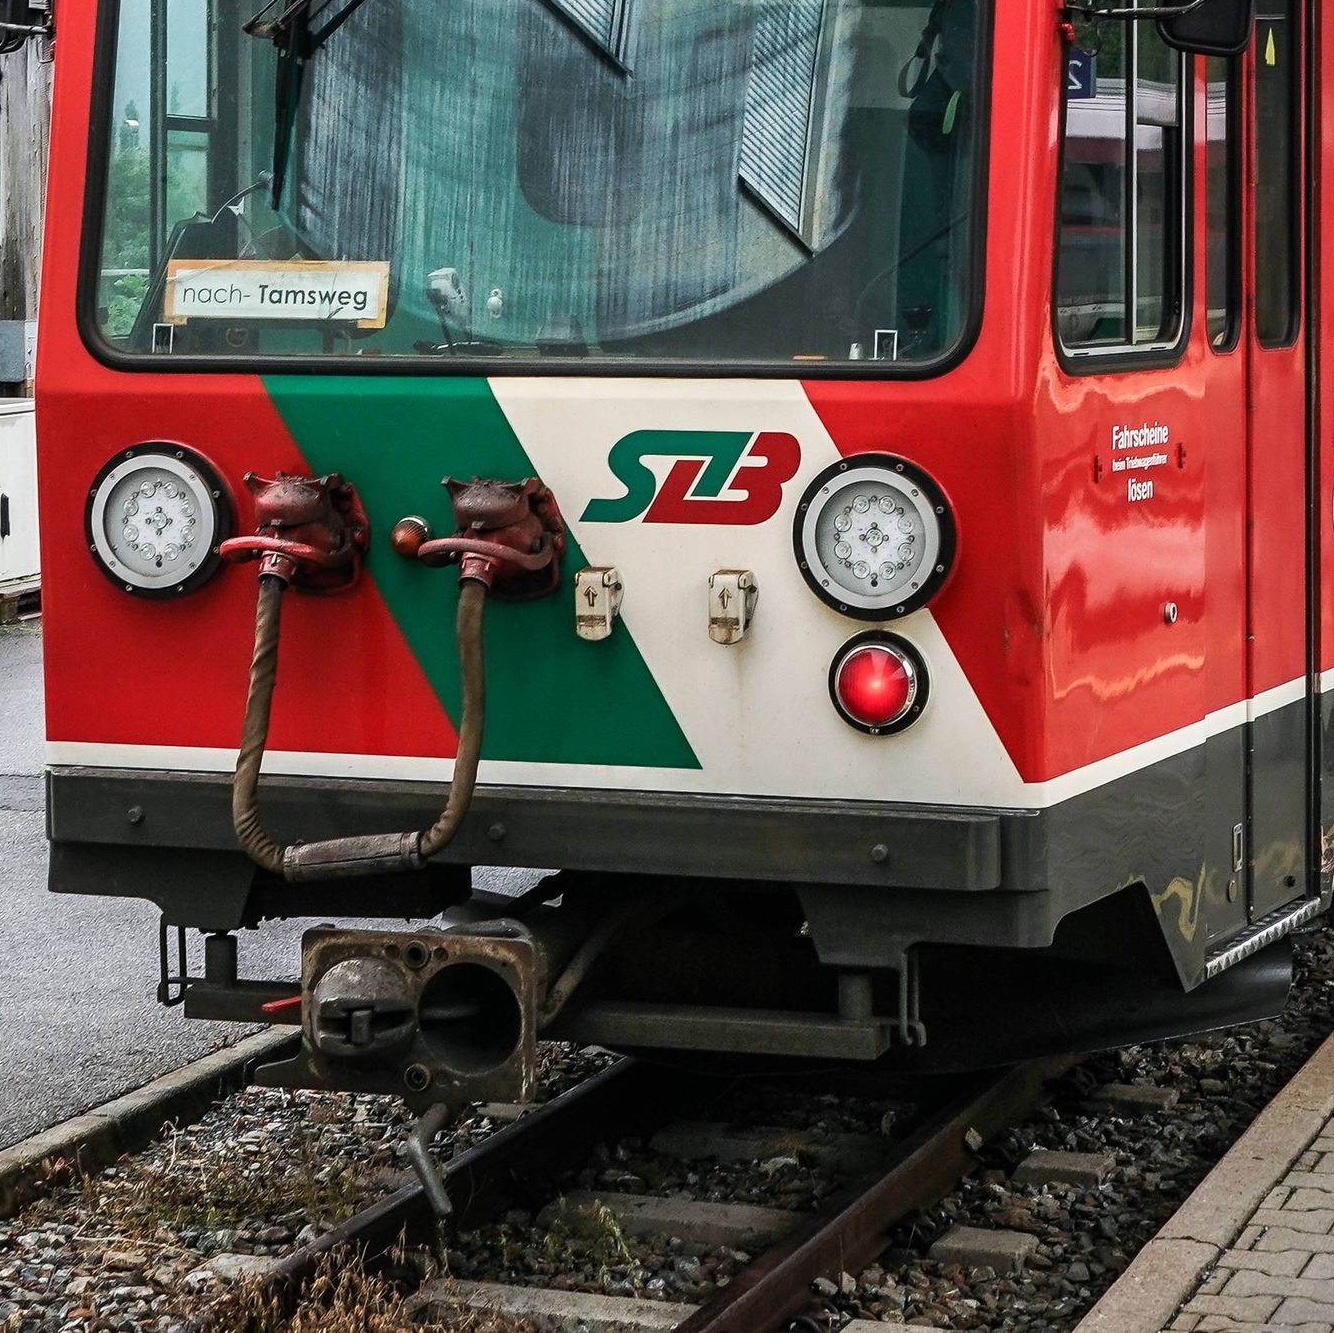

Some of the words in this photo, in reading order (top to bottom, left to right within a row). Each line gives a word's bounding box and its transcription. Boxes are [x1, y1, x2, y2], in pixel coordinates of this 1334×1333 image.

[183, 284, 251, 303] nach-
[259, 284, 368, 310] Tamsweg
[1112, 421, 1169, 450] Fahrscheine
[1128, 478, 1154, 502] lösen
